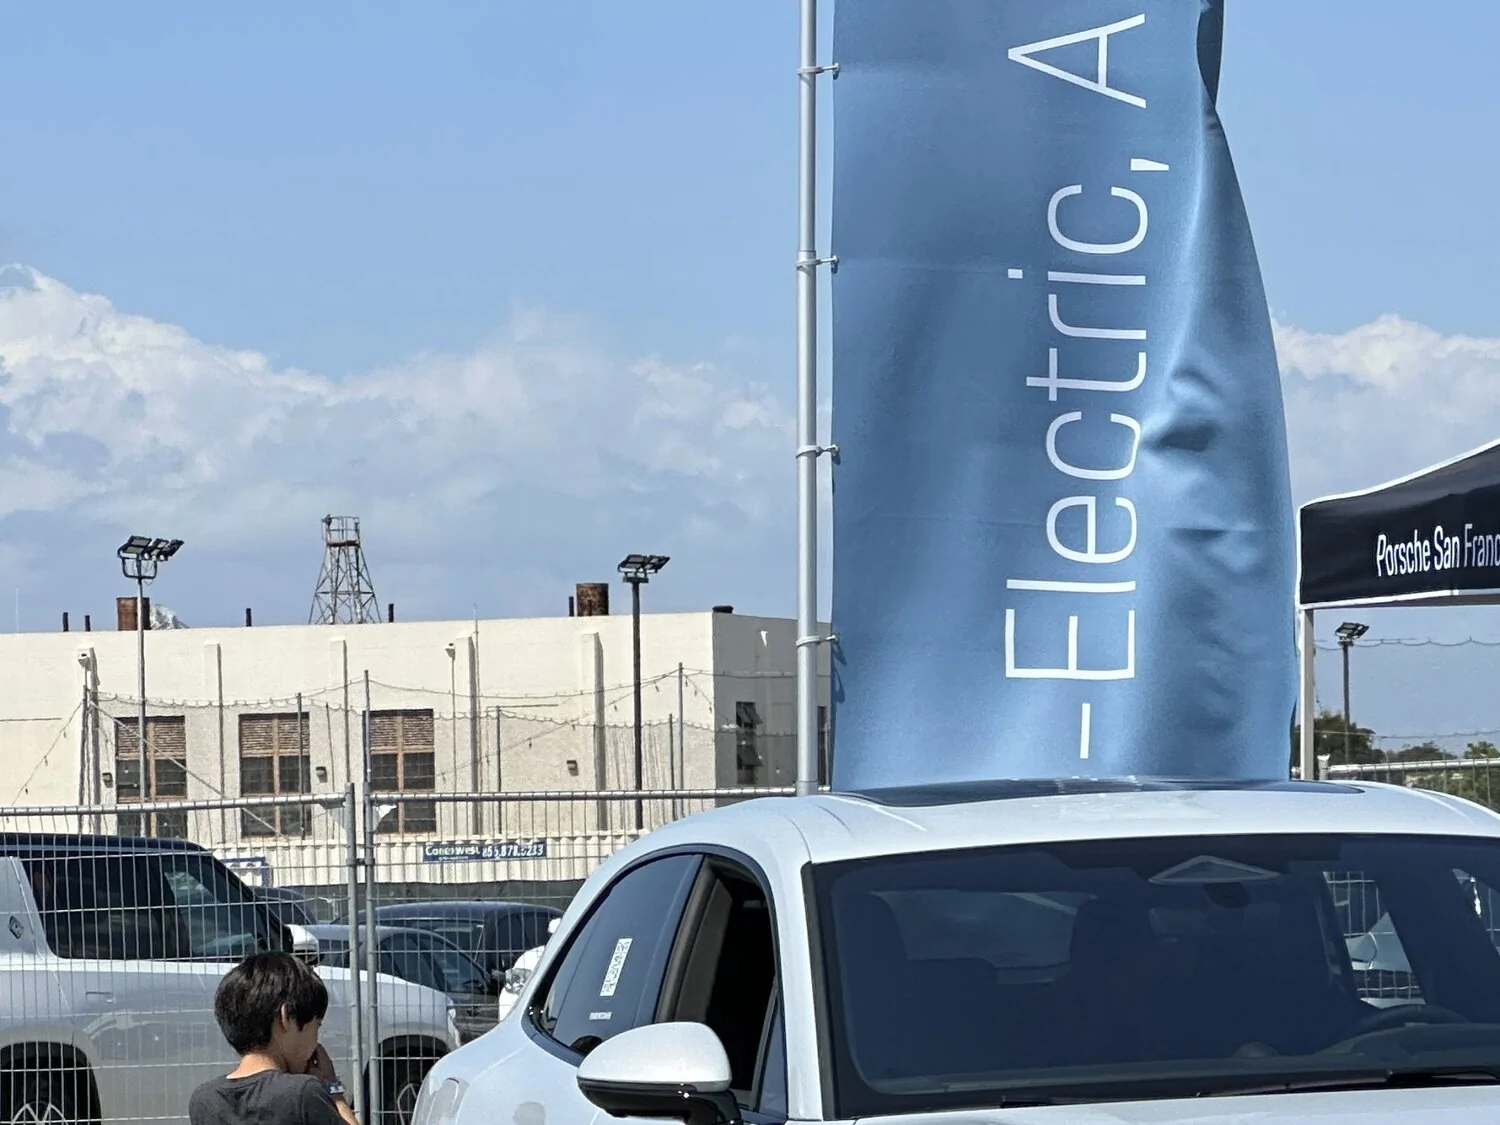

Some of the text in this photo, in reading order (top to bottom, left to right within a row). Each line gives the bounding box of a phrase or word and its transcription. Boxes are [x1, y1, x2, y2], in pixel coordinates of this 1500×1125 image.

[1008, 13, 1147, 108] A
[1376, 529, 1430, 577] Porsche
[1434, 525, 1460, 570] San
